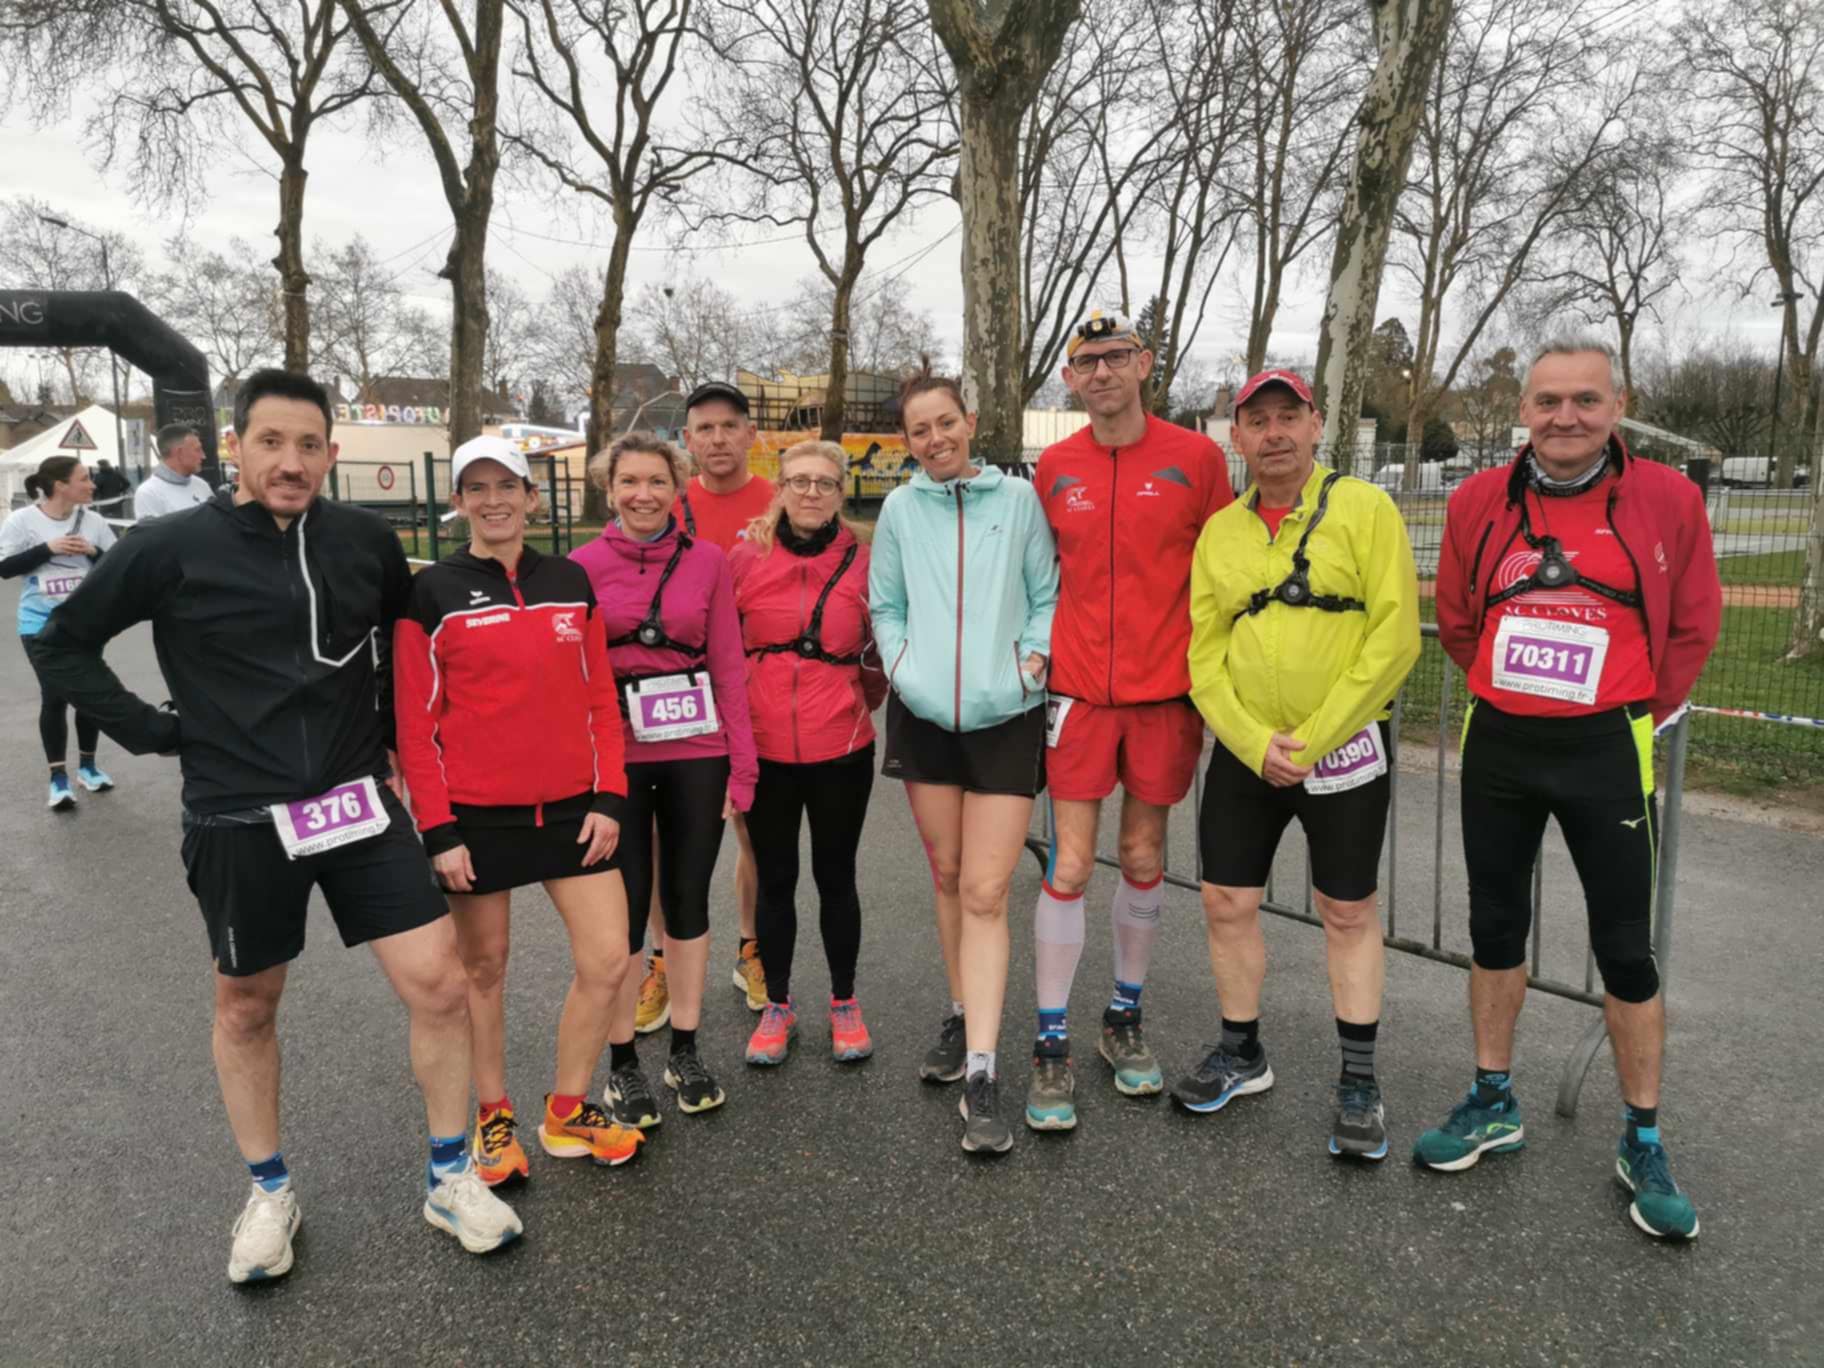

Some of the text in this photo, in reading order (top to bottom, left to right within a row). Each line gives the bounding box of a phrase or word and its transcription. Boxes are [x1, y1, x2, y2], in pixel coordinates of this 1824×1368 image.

[1508, 643, 1586, 676] 70311
[1497, 679, 1589, 701] www.protiming.fr
[651, 695, 698, 721] 456
[1317, 736, 1374, 771] 0390
[302, 791, 362, 831] 376
